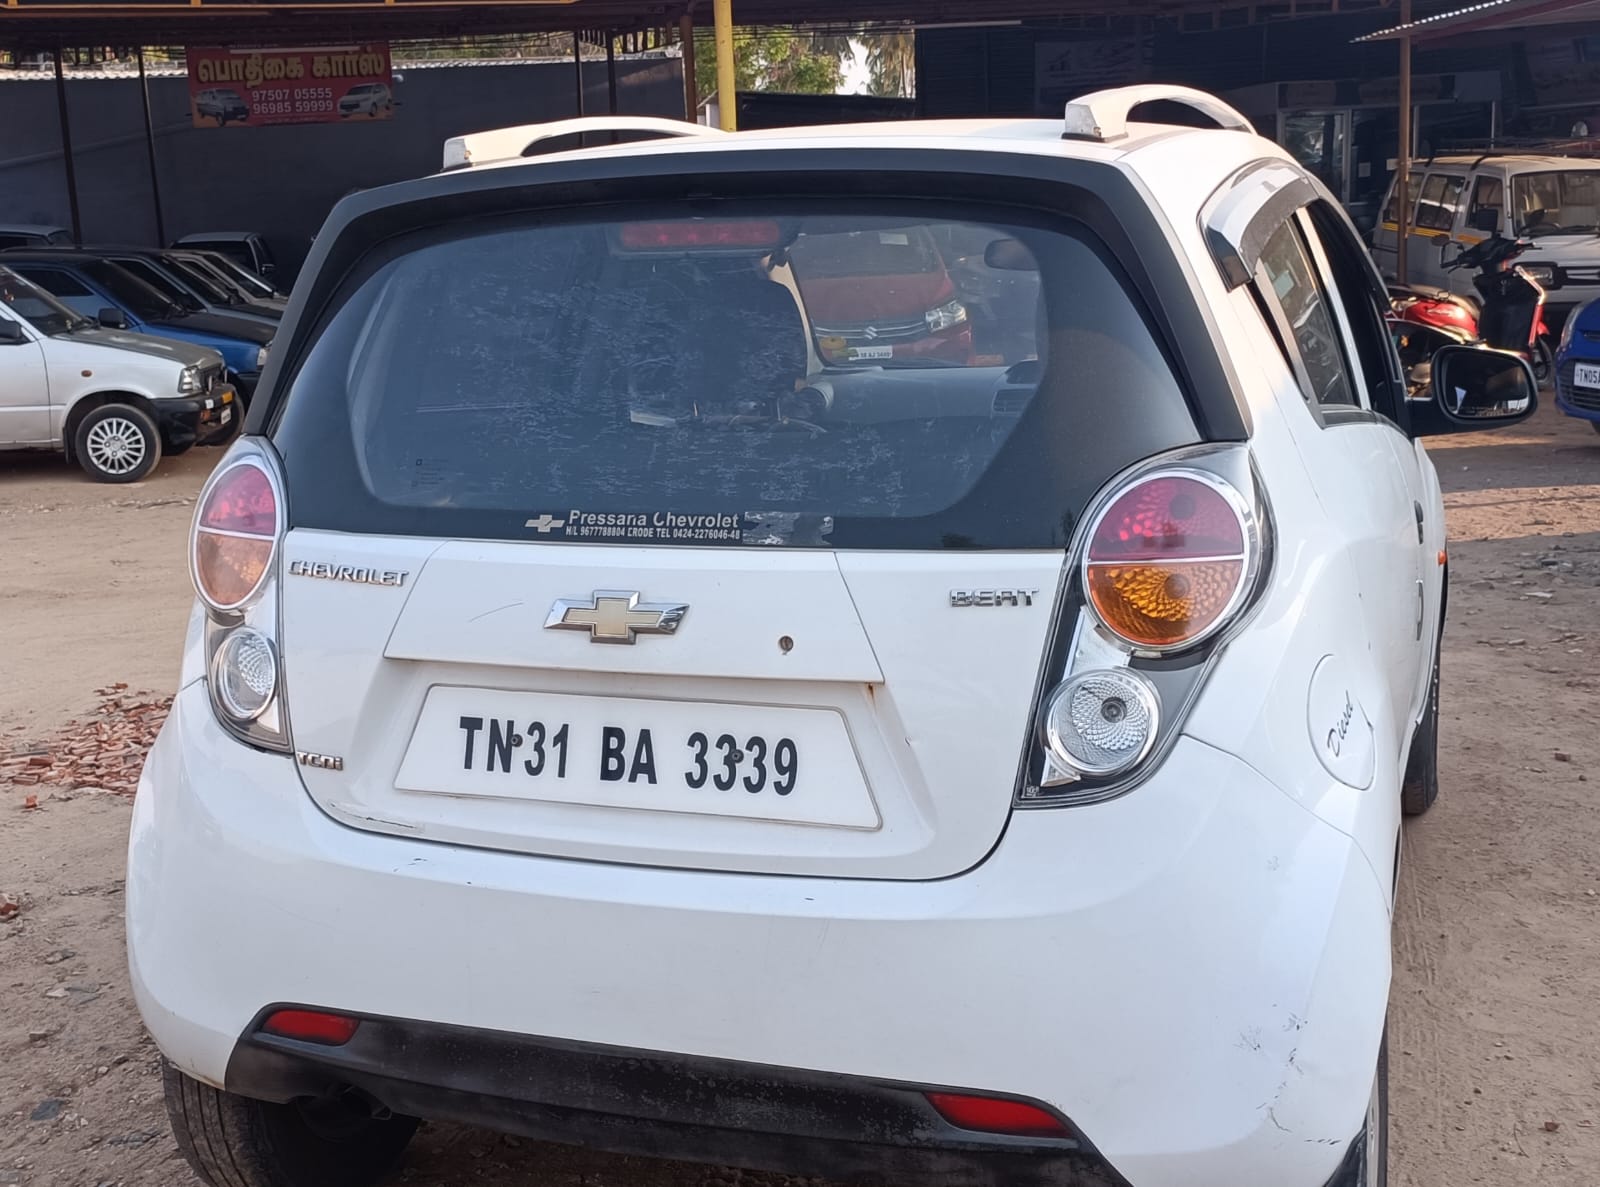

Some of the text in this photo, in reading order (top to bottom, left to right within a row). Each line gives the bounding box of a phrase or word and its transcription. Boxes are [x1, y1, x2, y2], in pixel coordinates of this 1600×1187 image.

[252, 88, 333, 102] 97507 05555
[252, 100, 334, 114] 96985 59999
[569, 509, 739, 528] Pressana Chevrolet
[656, 528, 671, 538] TEL
[289, 560, 409, 587] CHEVROLET
[950, 587, 1039, 607] BEAT
[1327, 689, 1354, 757] Diesel
[600, 726, 658, 785] BA
[684, 731, 798, 797] 3339
